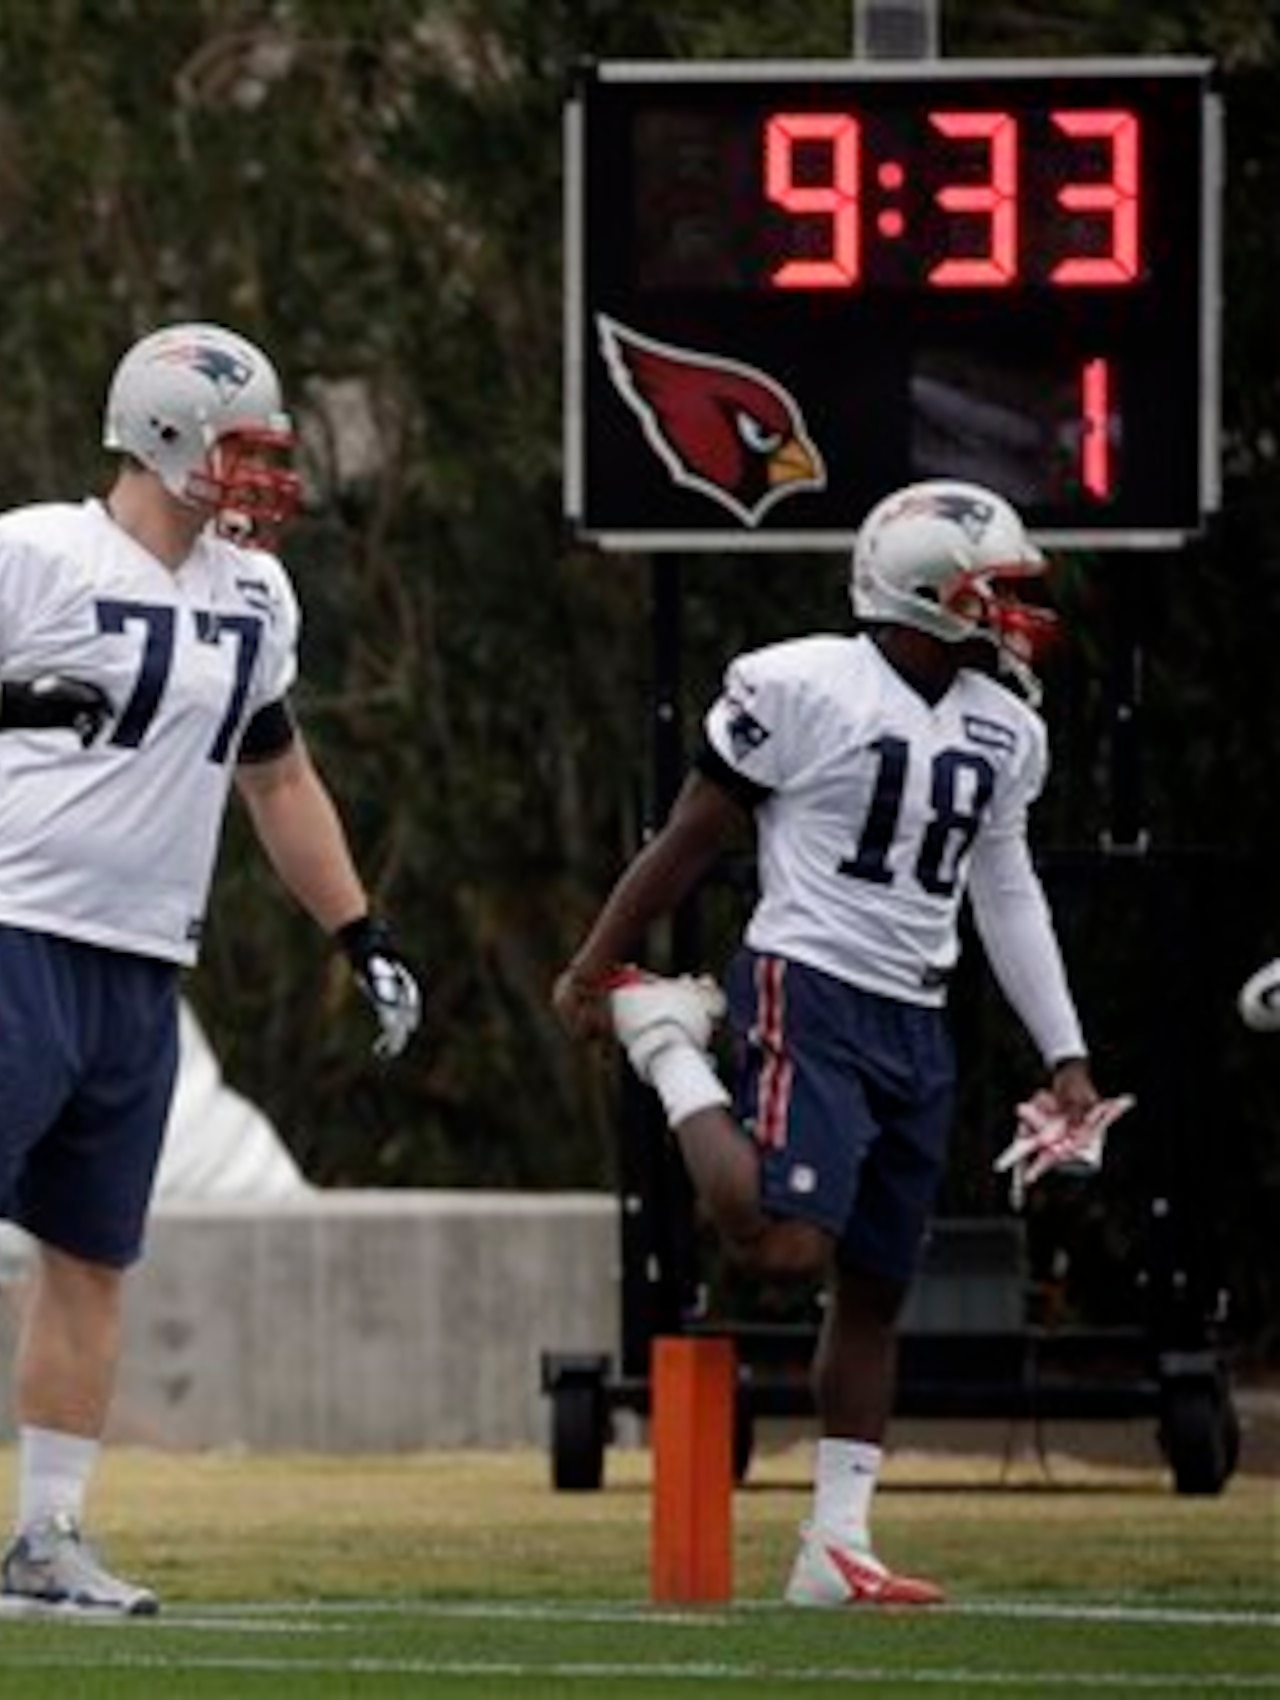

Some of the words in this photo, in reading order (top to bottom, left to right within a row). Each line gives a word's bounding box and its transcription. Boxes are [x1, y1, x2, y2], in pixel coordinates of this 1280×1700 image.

[764, 111, 1140, 286] 9:33
[1082, 357, 1110, 499] 1
[95, 600, 264, 764] 77
[836, 736, 995, 896] 18
